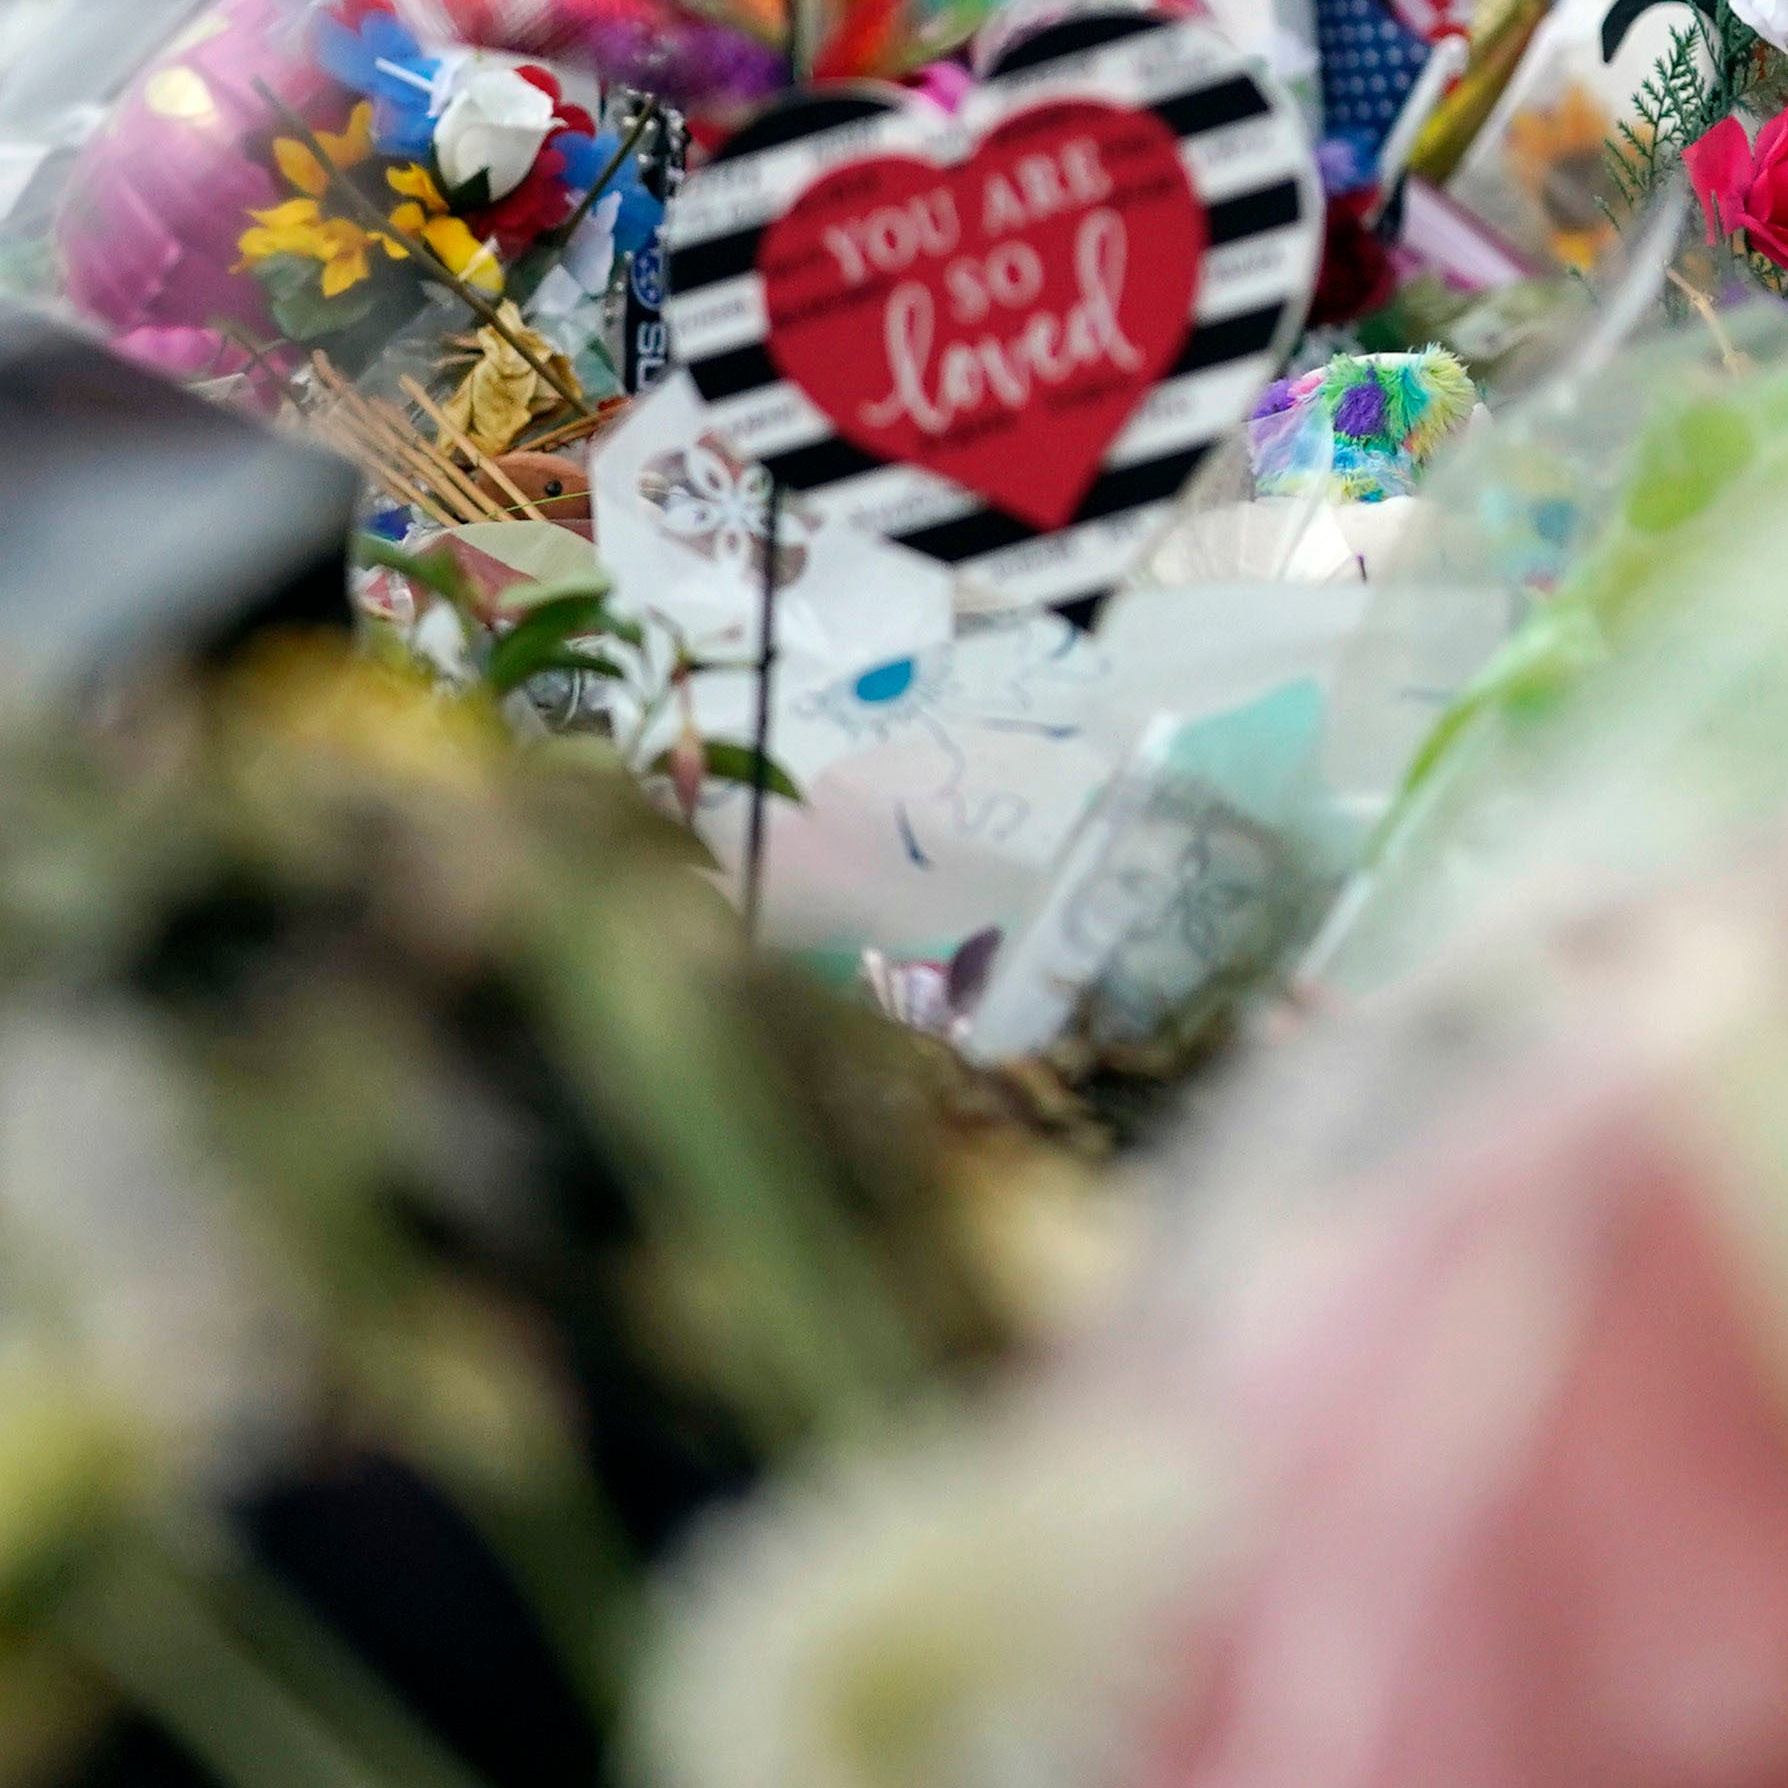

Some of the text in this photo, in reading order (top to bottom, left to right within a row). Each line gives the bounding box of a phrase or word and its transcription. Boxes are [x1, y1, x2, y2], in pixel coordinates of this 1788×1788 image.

[823, 188, 962, 285] YOU
[981, 137, 1115, 229] ARE
[857, 207, 1147, 434] loved
